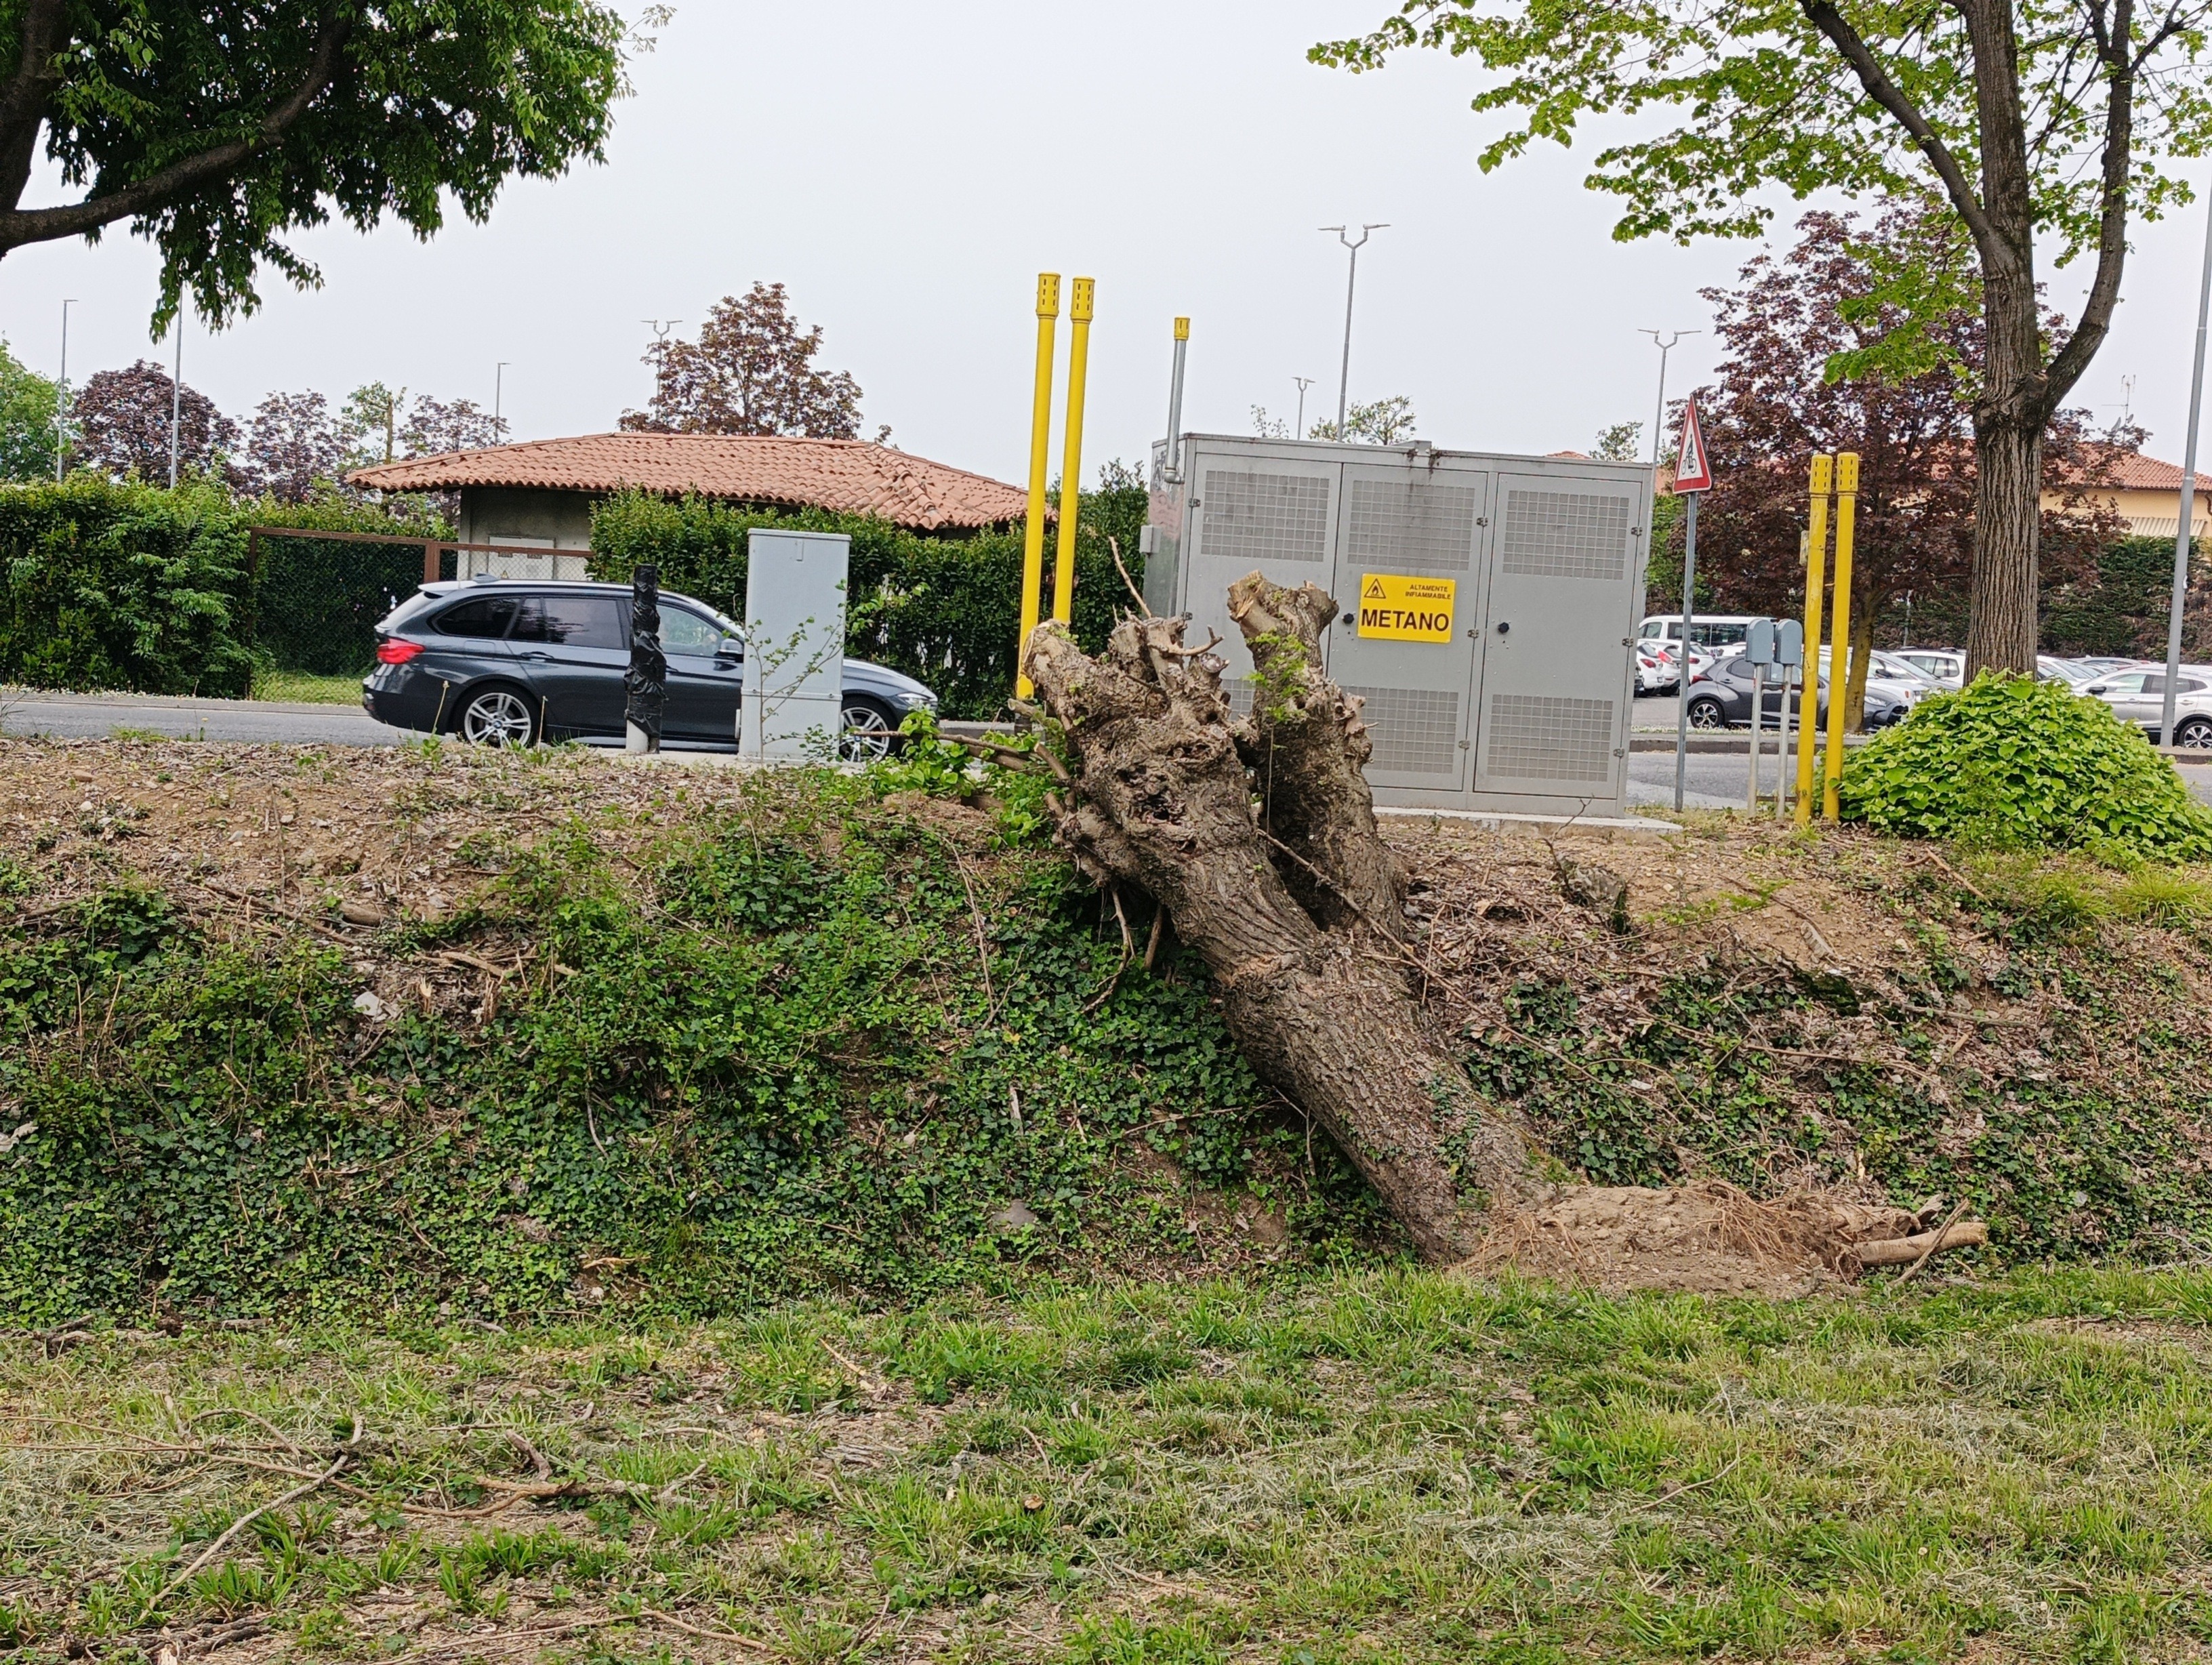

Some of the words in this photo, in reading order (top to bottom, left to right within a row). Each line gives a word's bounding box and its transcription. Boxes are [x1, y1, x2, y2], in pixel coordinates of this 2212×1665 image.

[1410, 584, 1448, 592] ALTAMENTE
[1405, 591, 1451, 600] INFIAMMABILE
[1361, 609, 1450, 632] METANO
